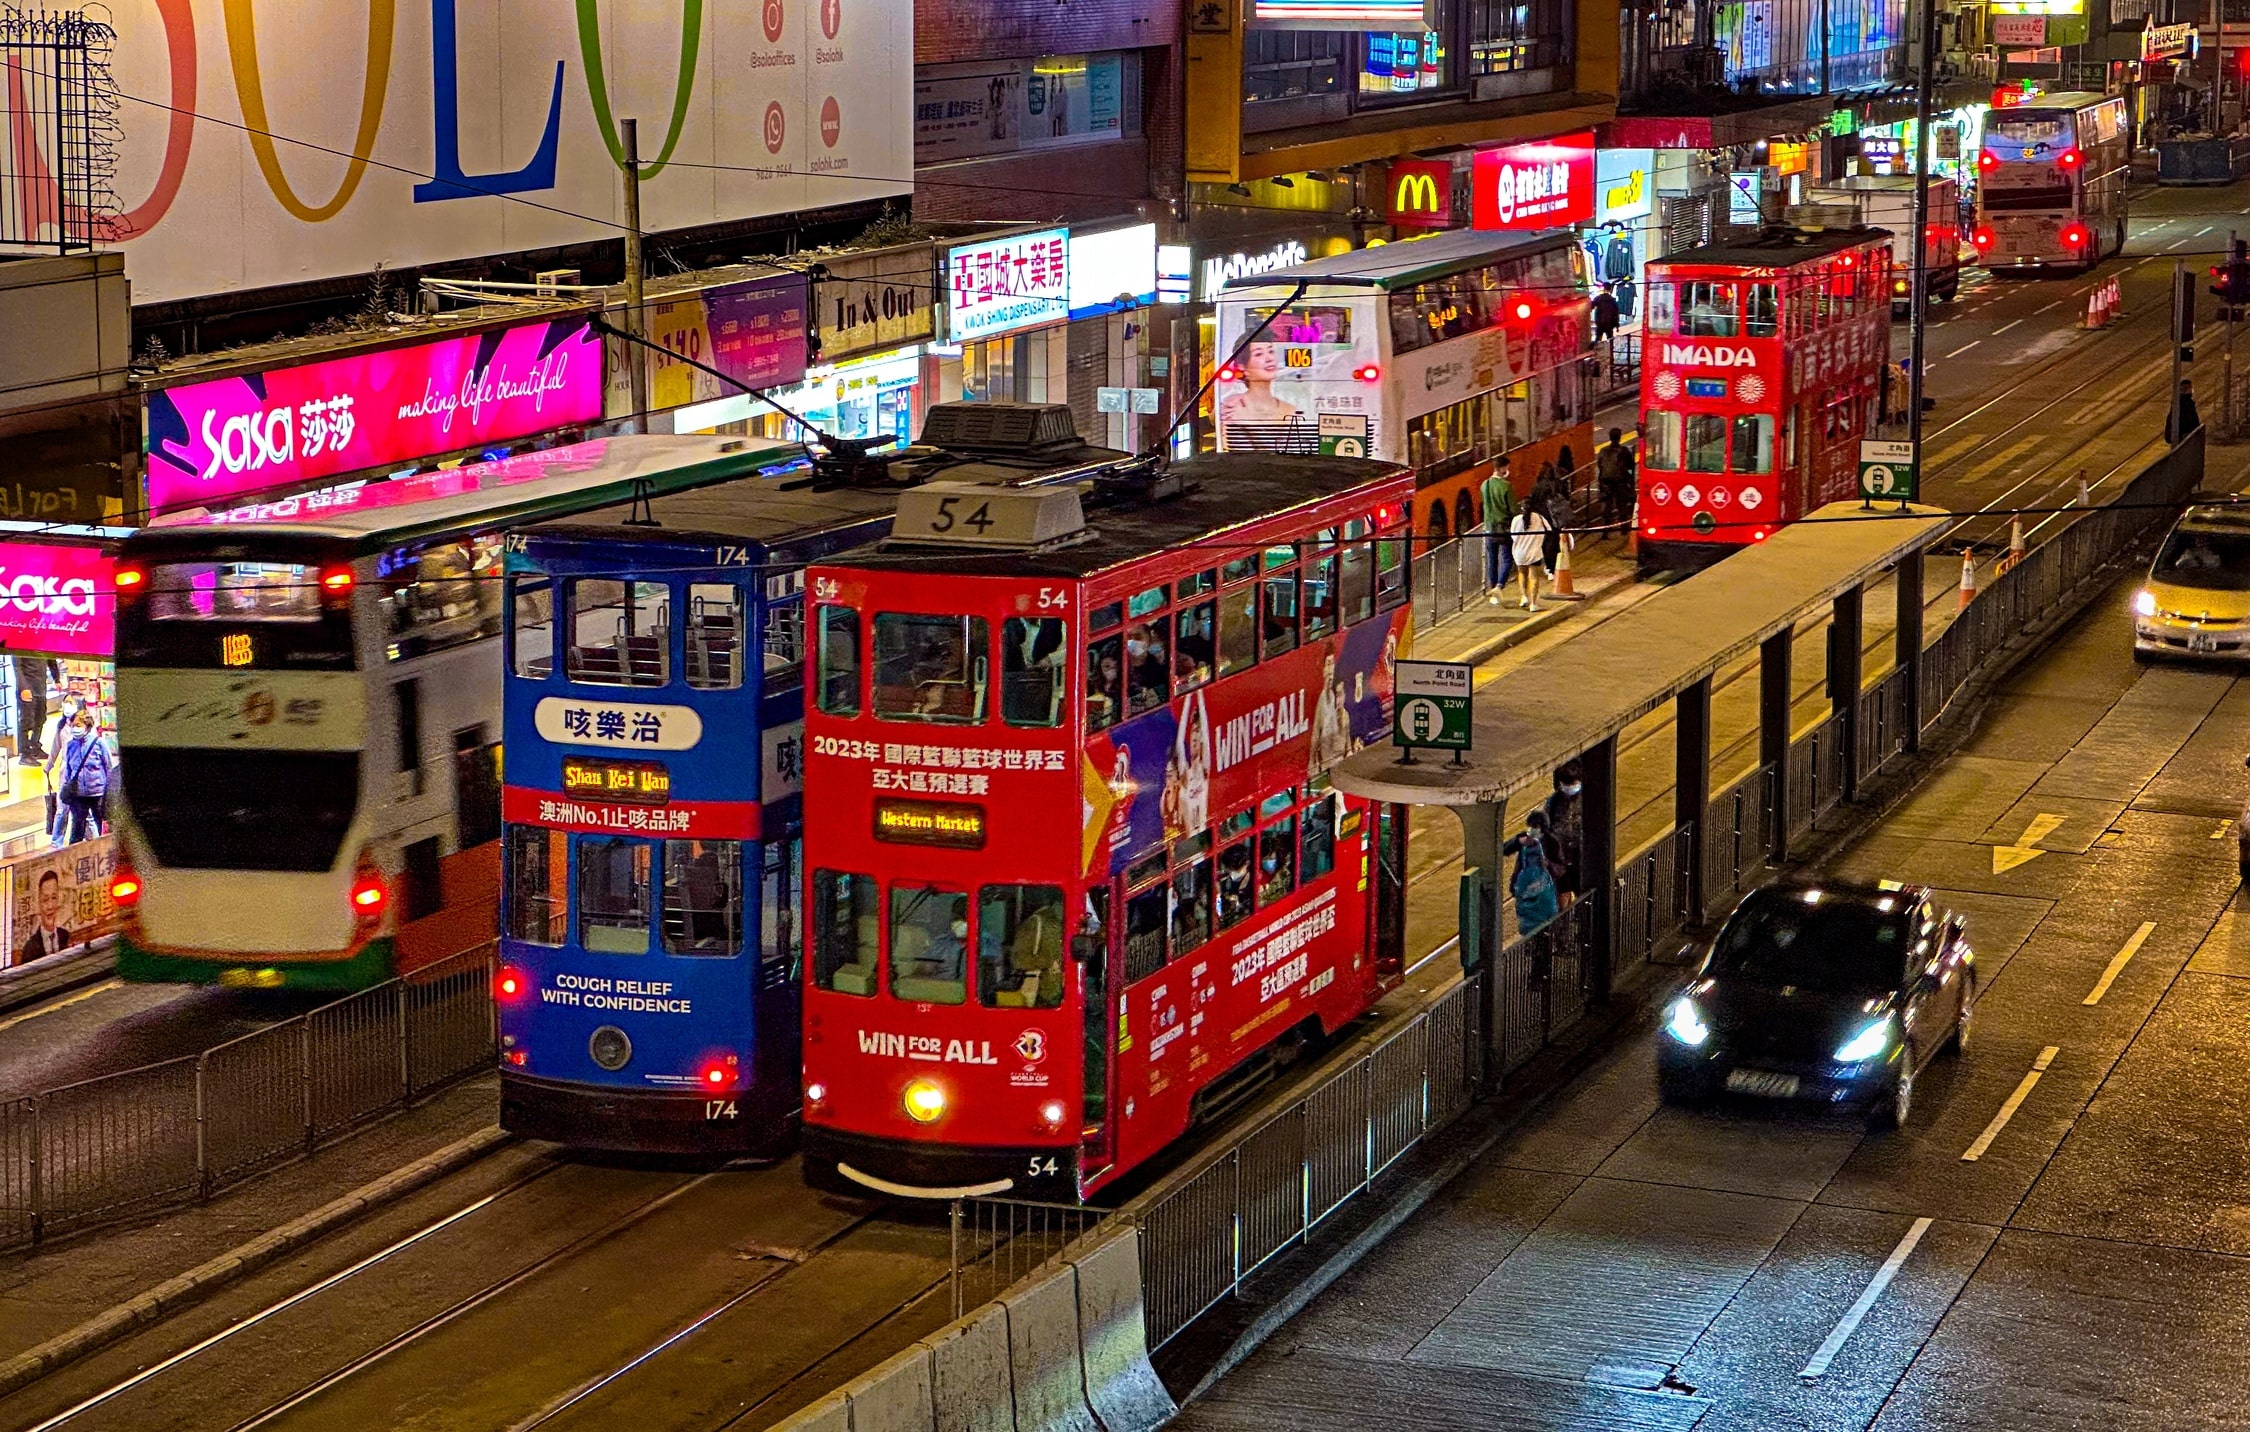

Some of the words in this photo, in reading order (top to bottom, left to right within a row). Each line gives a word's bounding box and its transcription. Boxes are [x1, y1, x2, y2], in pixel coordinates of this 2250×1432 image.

[836, 296, 857, 333] In
[882, 286, 915, 321] Out
[1287, 349, 1311, 368] 106
[1662, 343, 1757, 367] IMADA
[398, 377, 458, 434] making
[461, 365, 494, 426] life
[495, 352, 568, 413] beautiful
[300, 393, 355, 458] 莎莎
[931, 497, 994, 535] 54
[716, 546, 749, 566] 174
[815, 576, 838, 596] 54
[1037, 588, 1068, 609] 54
[1435, 669, 1465, 680] 北角道
[1443, 699, 1466, 709] 32W
[563, 708, 662, 744] 咳樂治
[1215, 715, 1250, 773] WIN
[1251, 705, 1274, 734] FOR
[1275, 688, 1309, 744] ALL
[814, 735, 881, 762] 2023年
[608, 769, 634, 790] Kei
[872, 768, 990, 796] 亞大區預選賽
[881, 810, 932, 829] Western
[936, 814, 980, 832] Market
[556, 974, 612, 993] COUGH
[615, 979, 673, 996] RELIEF
[541, 988, 580, 1006] WITH
[583, 993, 692, 1014] CONFIDENCE
[858, 1029, 905, 1058] WIN
[908, 1036, 942, 1053] FOR
[944, 1039, 998, 1065] ALL
[705, 1100, 738, 1120] 174
[1028, 1155, 1058, 1177] 54
